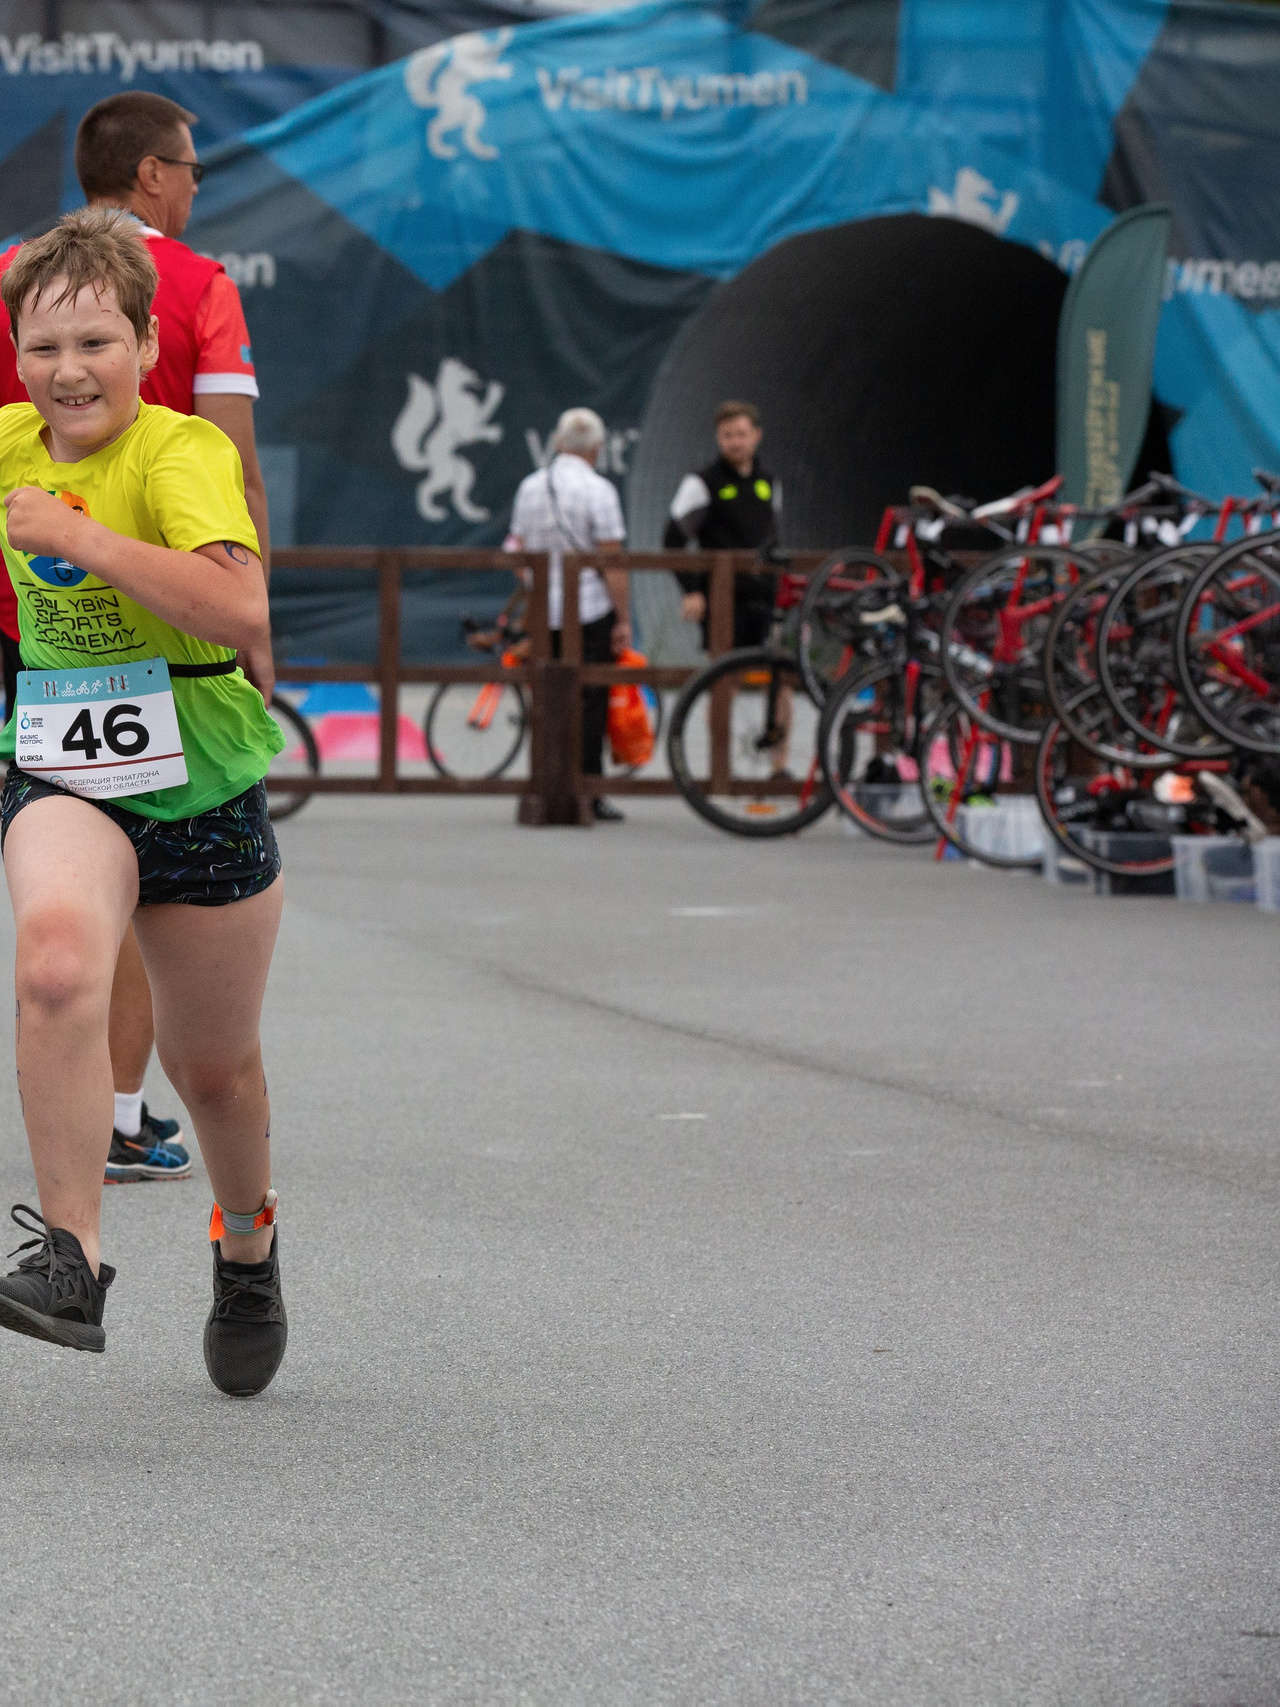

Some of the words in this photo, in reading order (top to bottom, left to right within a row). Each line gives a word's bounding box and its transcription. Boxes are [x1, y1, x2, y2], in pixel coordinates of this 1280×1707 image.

[535, 66, 808, 121] VisitTyumen
[61, 703, 150, 760] 46
[68, 777, 111, 786] ФЕДЕРАЦИЯ
[112, 770, 160, 783] ТРИАТЛОНА
[113, 779, 150, 790] ОБЛАСТИ
